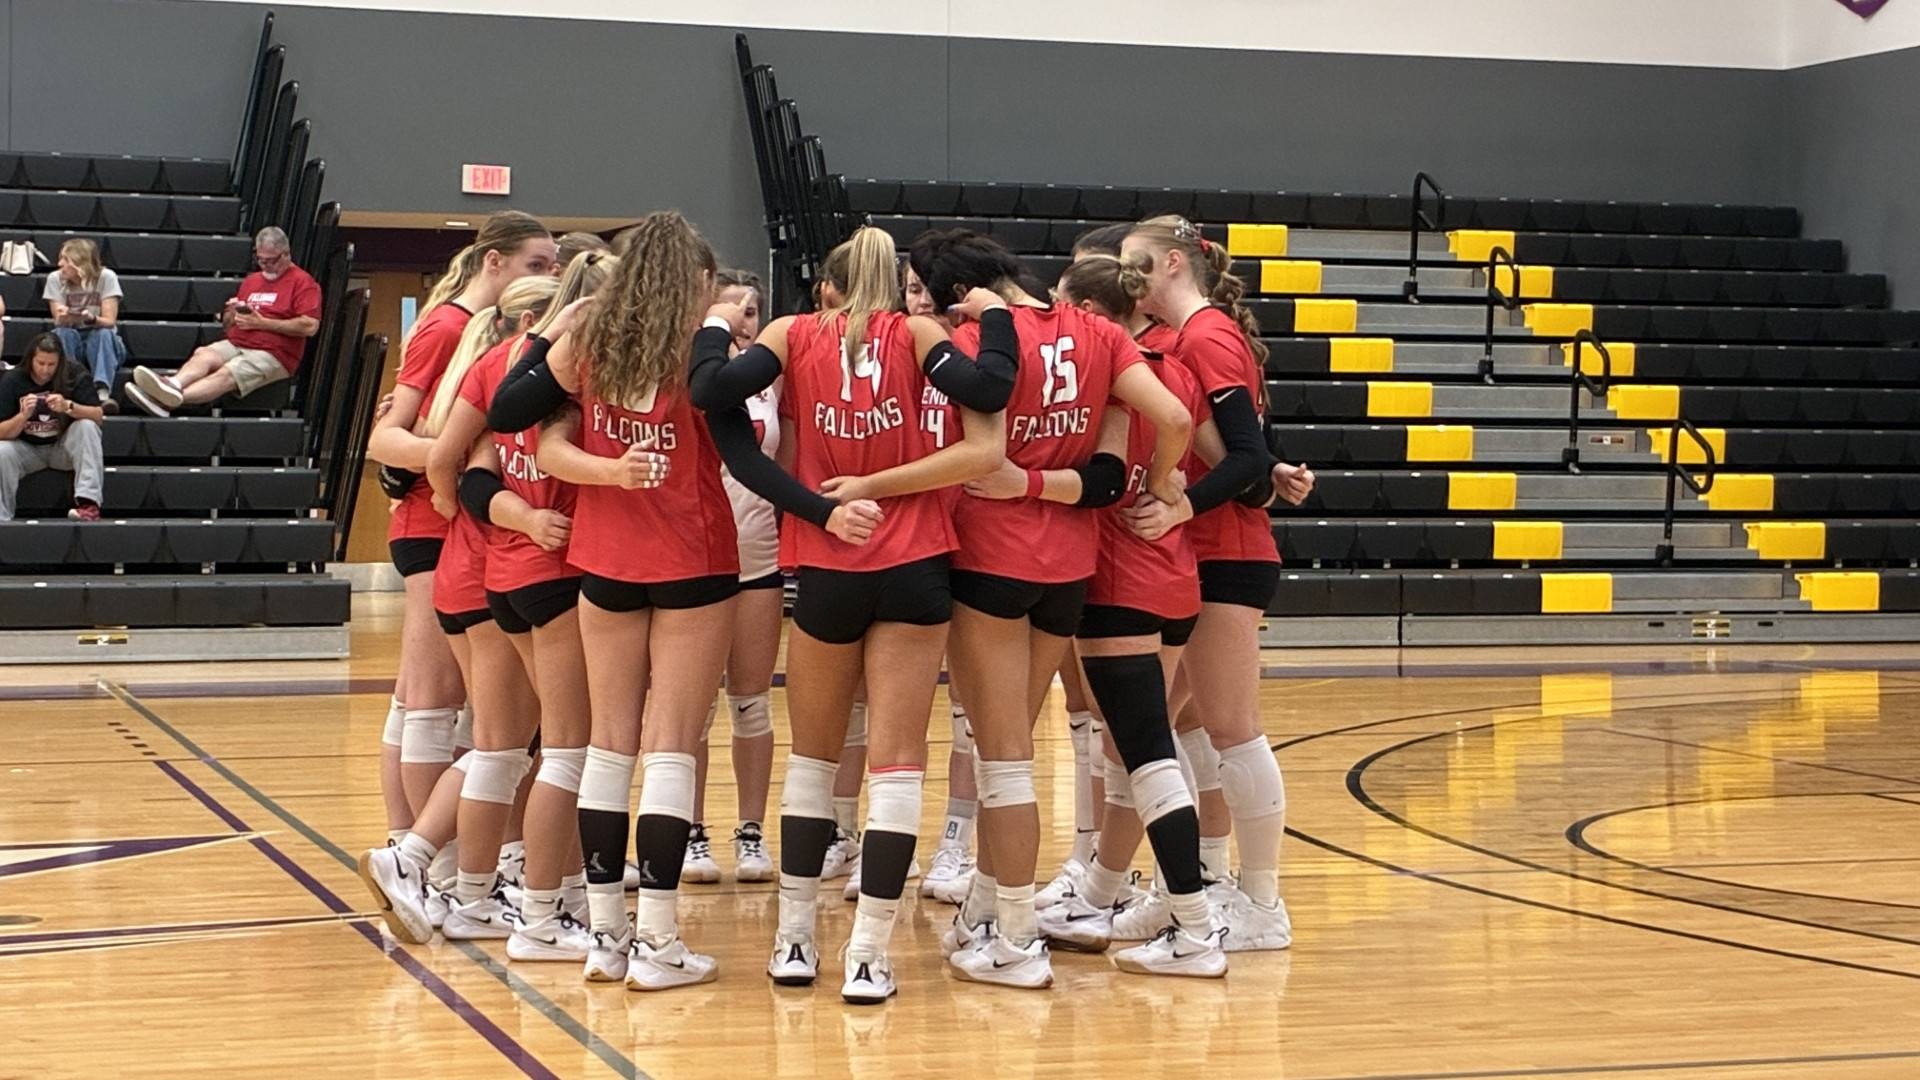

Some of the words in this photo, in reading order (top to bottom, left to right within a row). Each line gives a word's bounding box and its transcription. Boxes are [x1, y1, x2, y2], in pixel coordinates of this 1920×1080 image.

[472, 167, 503, 191] EXIT
[839, 336, 882, 402] 14
[1040, 335, 1078, 408] 15
[593, 403, 677, 451] FLCONS
